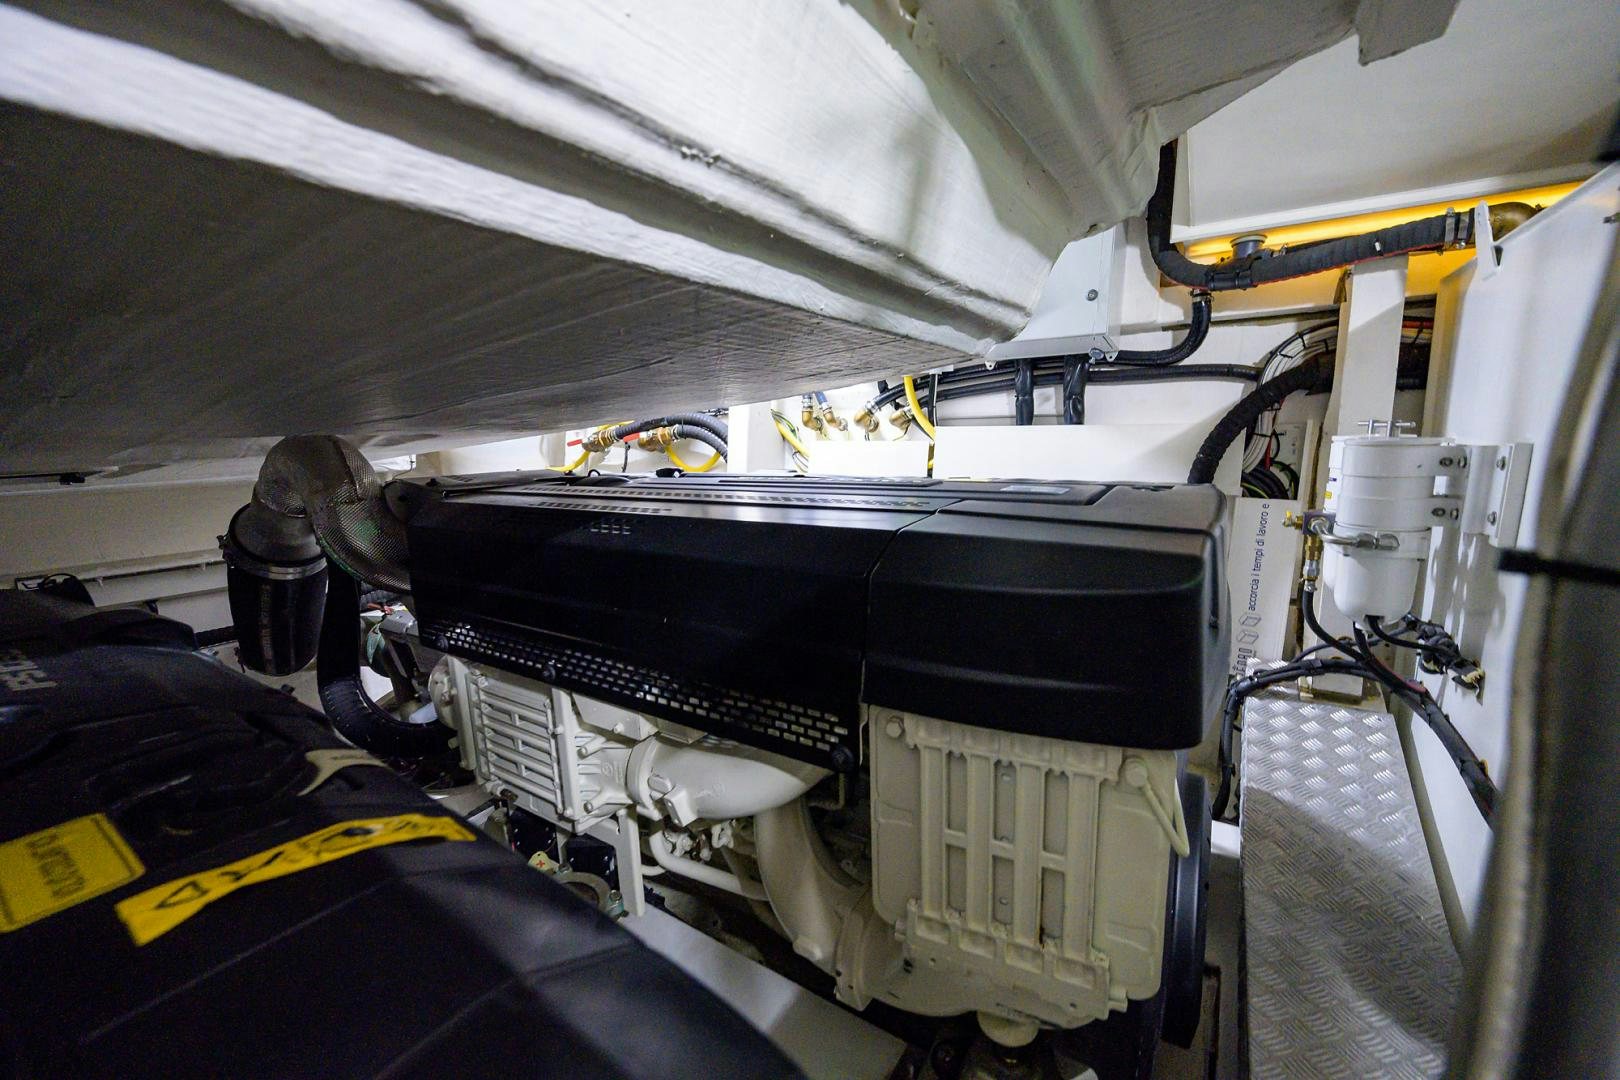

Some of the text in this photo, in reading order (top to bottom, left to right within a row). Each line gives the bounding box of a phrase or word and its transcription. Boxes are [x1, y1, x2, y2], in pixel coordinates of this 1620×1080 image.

[1256, 512, 1269, 536] lavoro
[1256, 538, 1265, 547] di
[1252, 548, 1264, 572] tempi
[1248, 579, 1260, 611] accorcia
